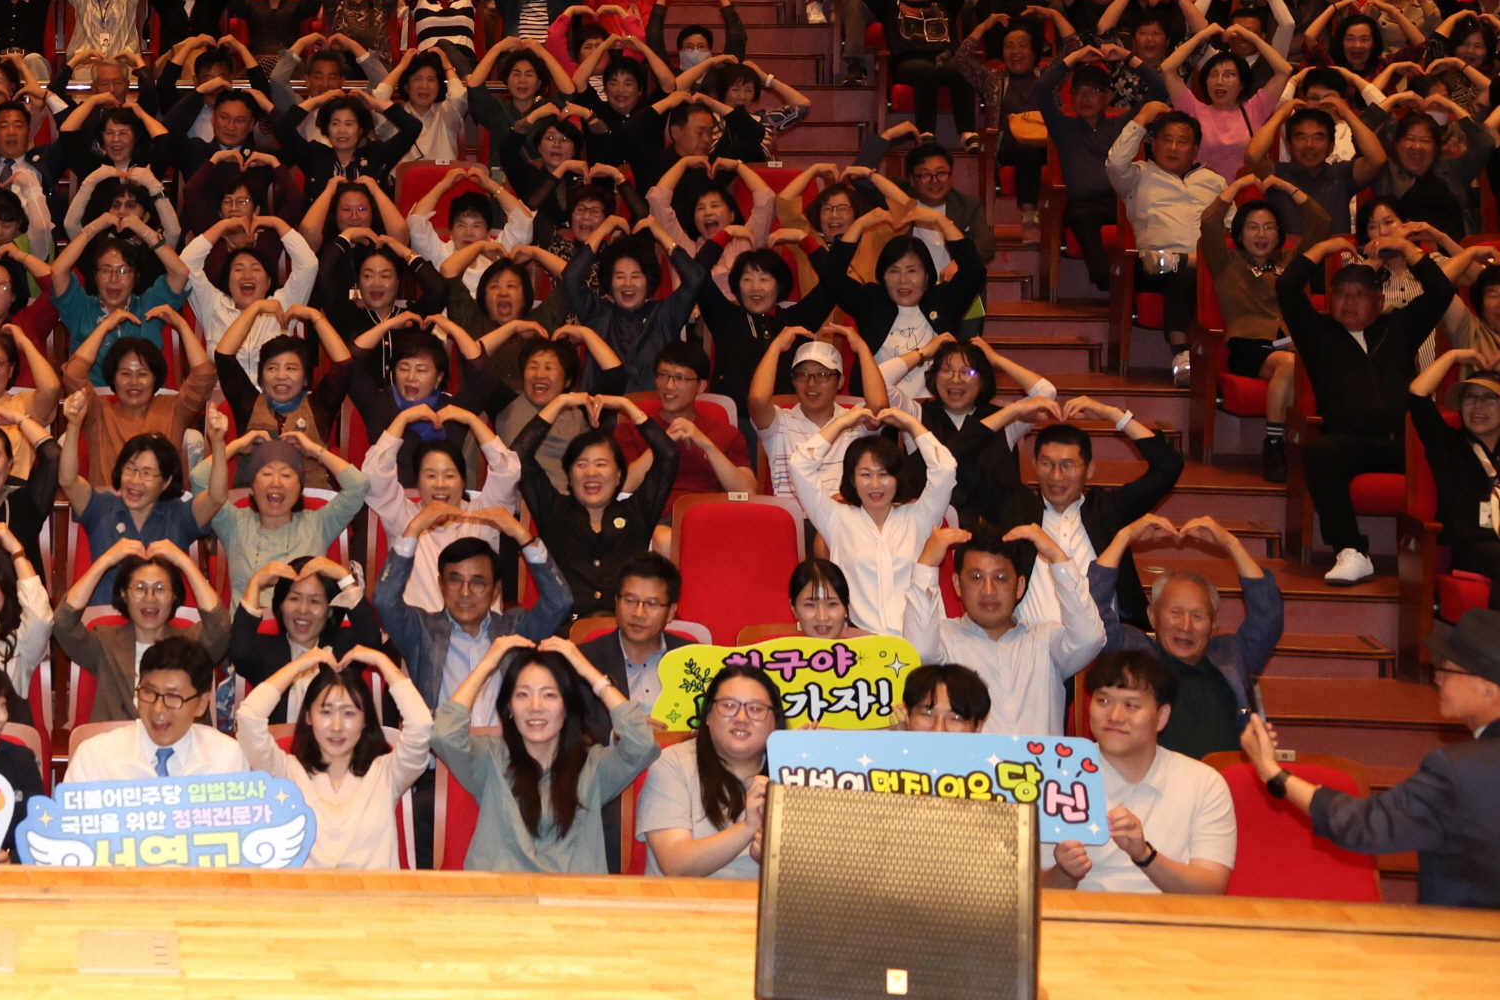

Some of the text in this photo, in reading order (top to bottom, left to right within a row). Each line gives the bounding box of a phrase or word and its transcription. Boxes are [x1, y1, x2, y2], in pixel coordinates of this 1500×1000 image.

[781, 677, 894, 722] 가자!
[62, 784, 183, 811] 더불어민주당
[60, 804, 273, 836] 국민을 위한 정책전문가
